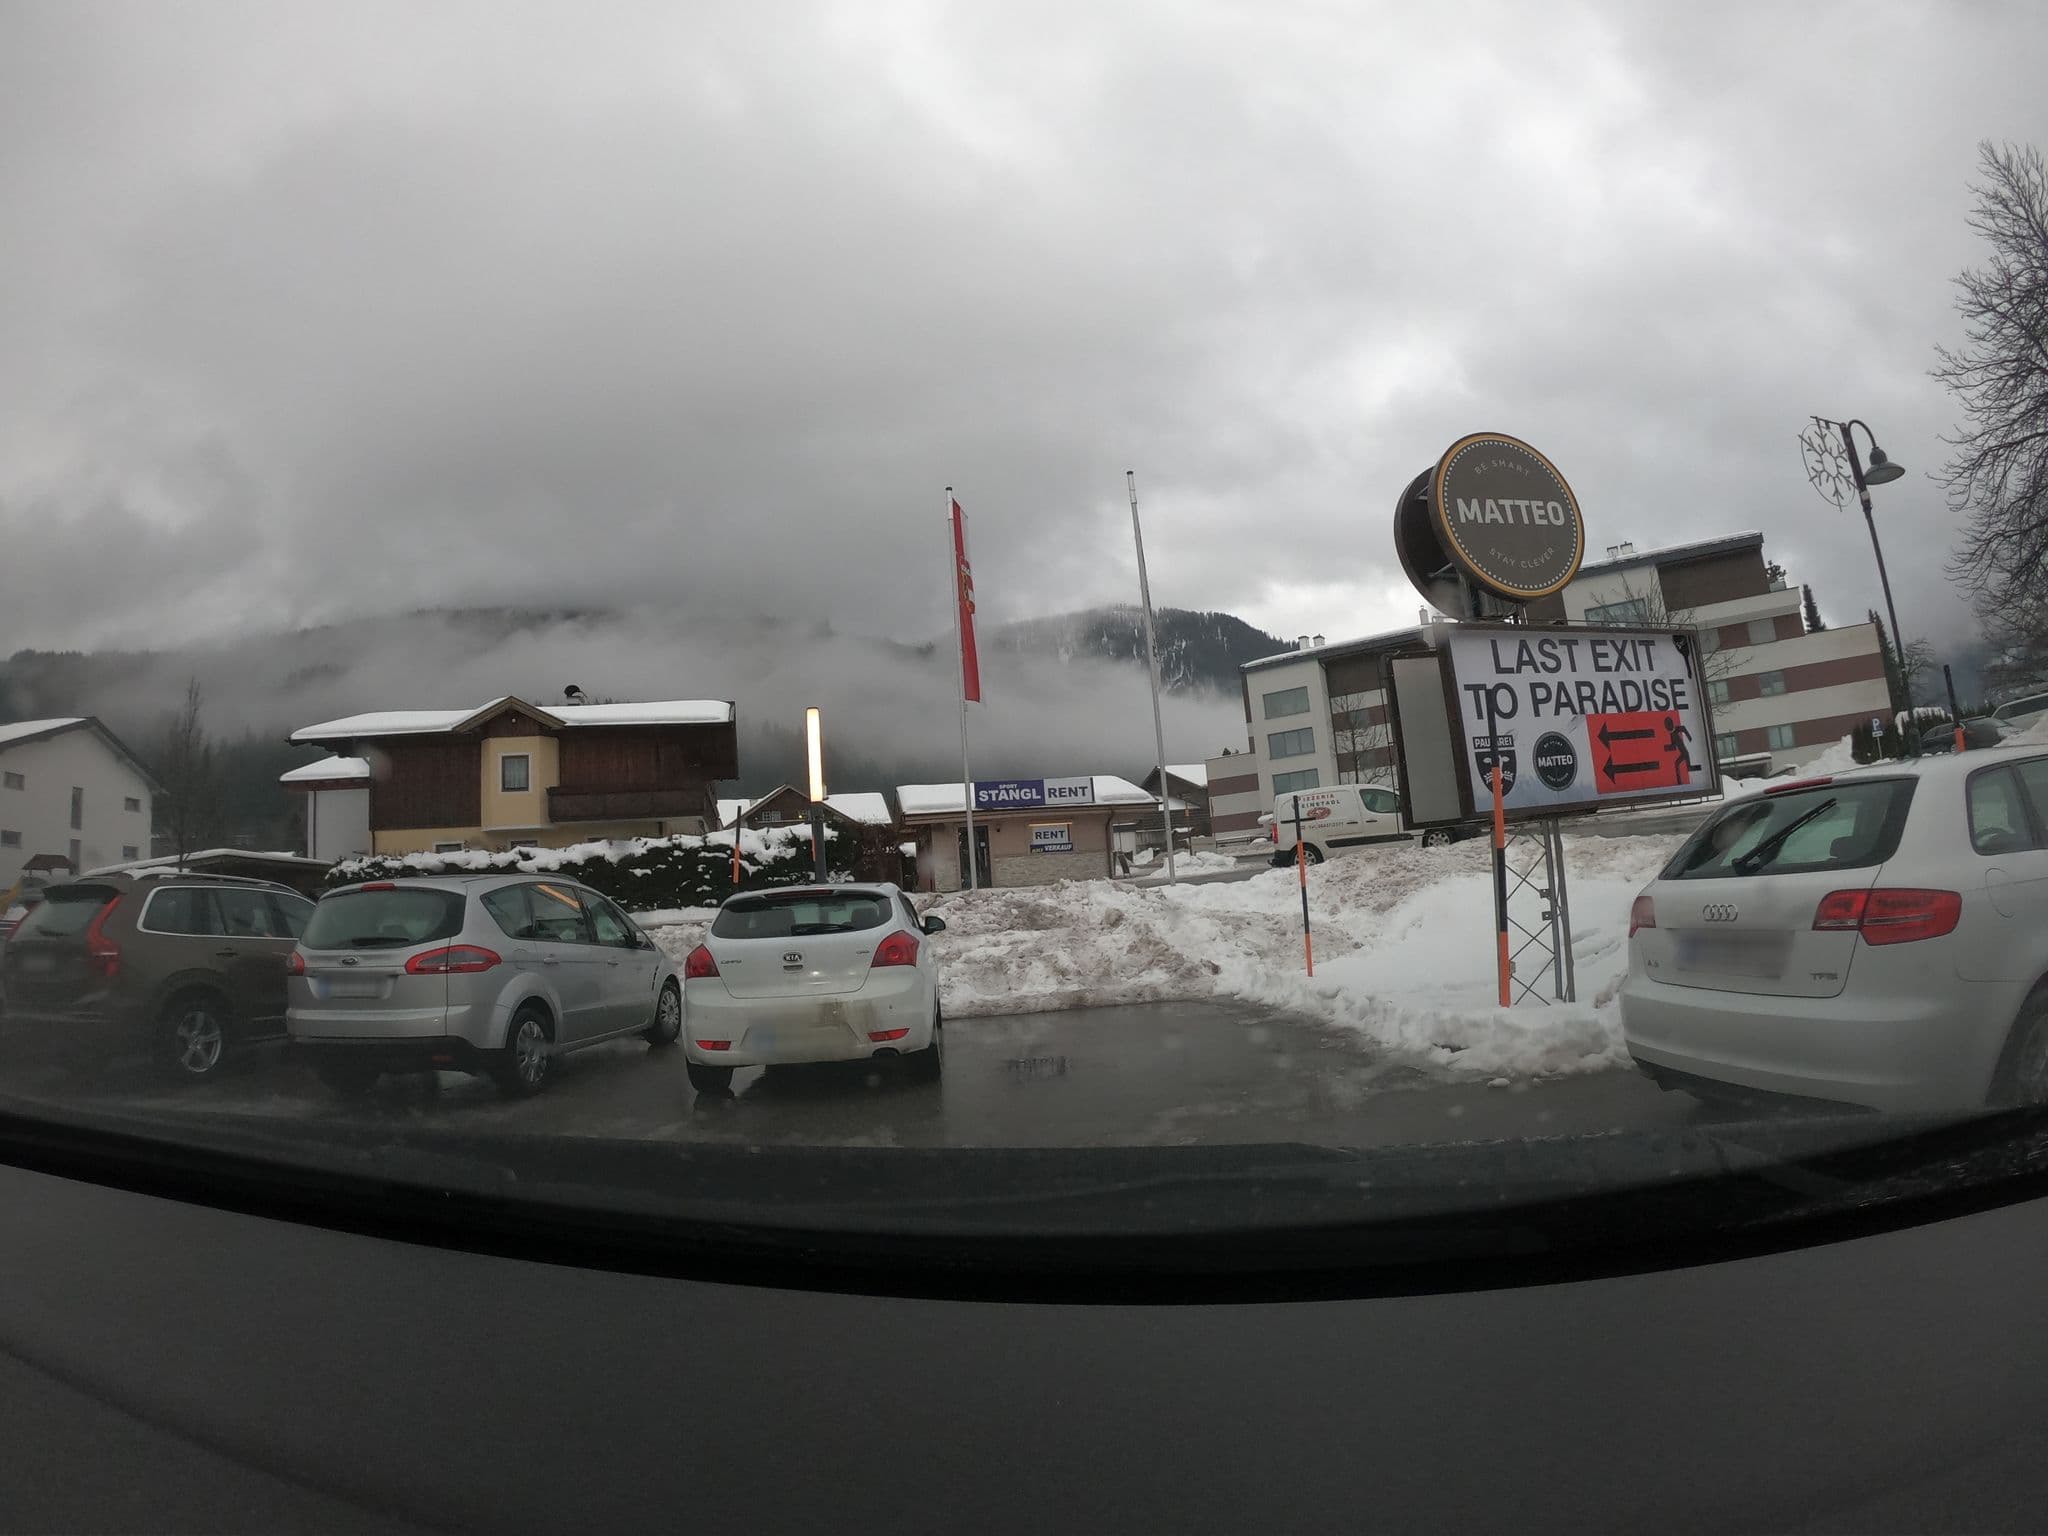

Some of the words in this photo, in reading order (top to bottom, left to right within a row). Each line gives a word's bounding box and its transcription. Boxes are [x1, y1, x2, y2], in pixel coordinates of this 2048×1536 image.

[1474, 463, 1488, 475] BE
[1491, 460, 1530, 477] SMART
[1456, 498, 1565, 526] MATTEO
[1520, 547, 1555, 569] CLEVER
[1490, 638, 1579, 675] LAST
[1590, 639, 1656, 673] EXIT
[1464, 682, 1519, 720] TO
[1529, 678, 1690, 718] PARADISE
[1872, 718, 1880, 731] P
[1538, 754, 1573, 767] MATTEO
[979, 788, 1041, 801] STANGL
[1048, 786, 1088, 798] RENT
[1035, 830, 1065, 839] RENT
[785, 954, 800, 962] KIA
